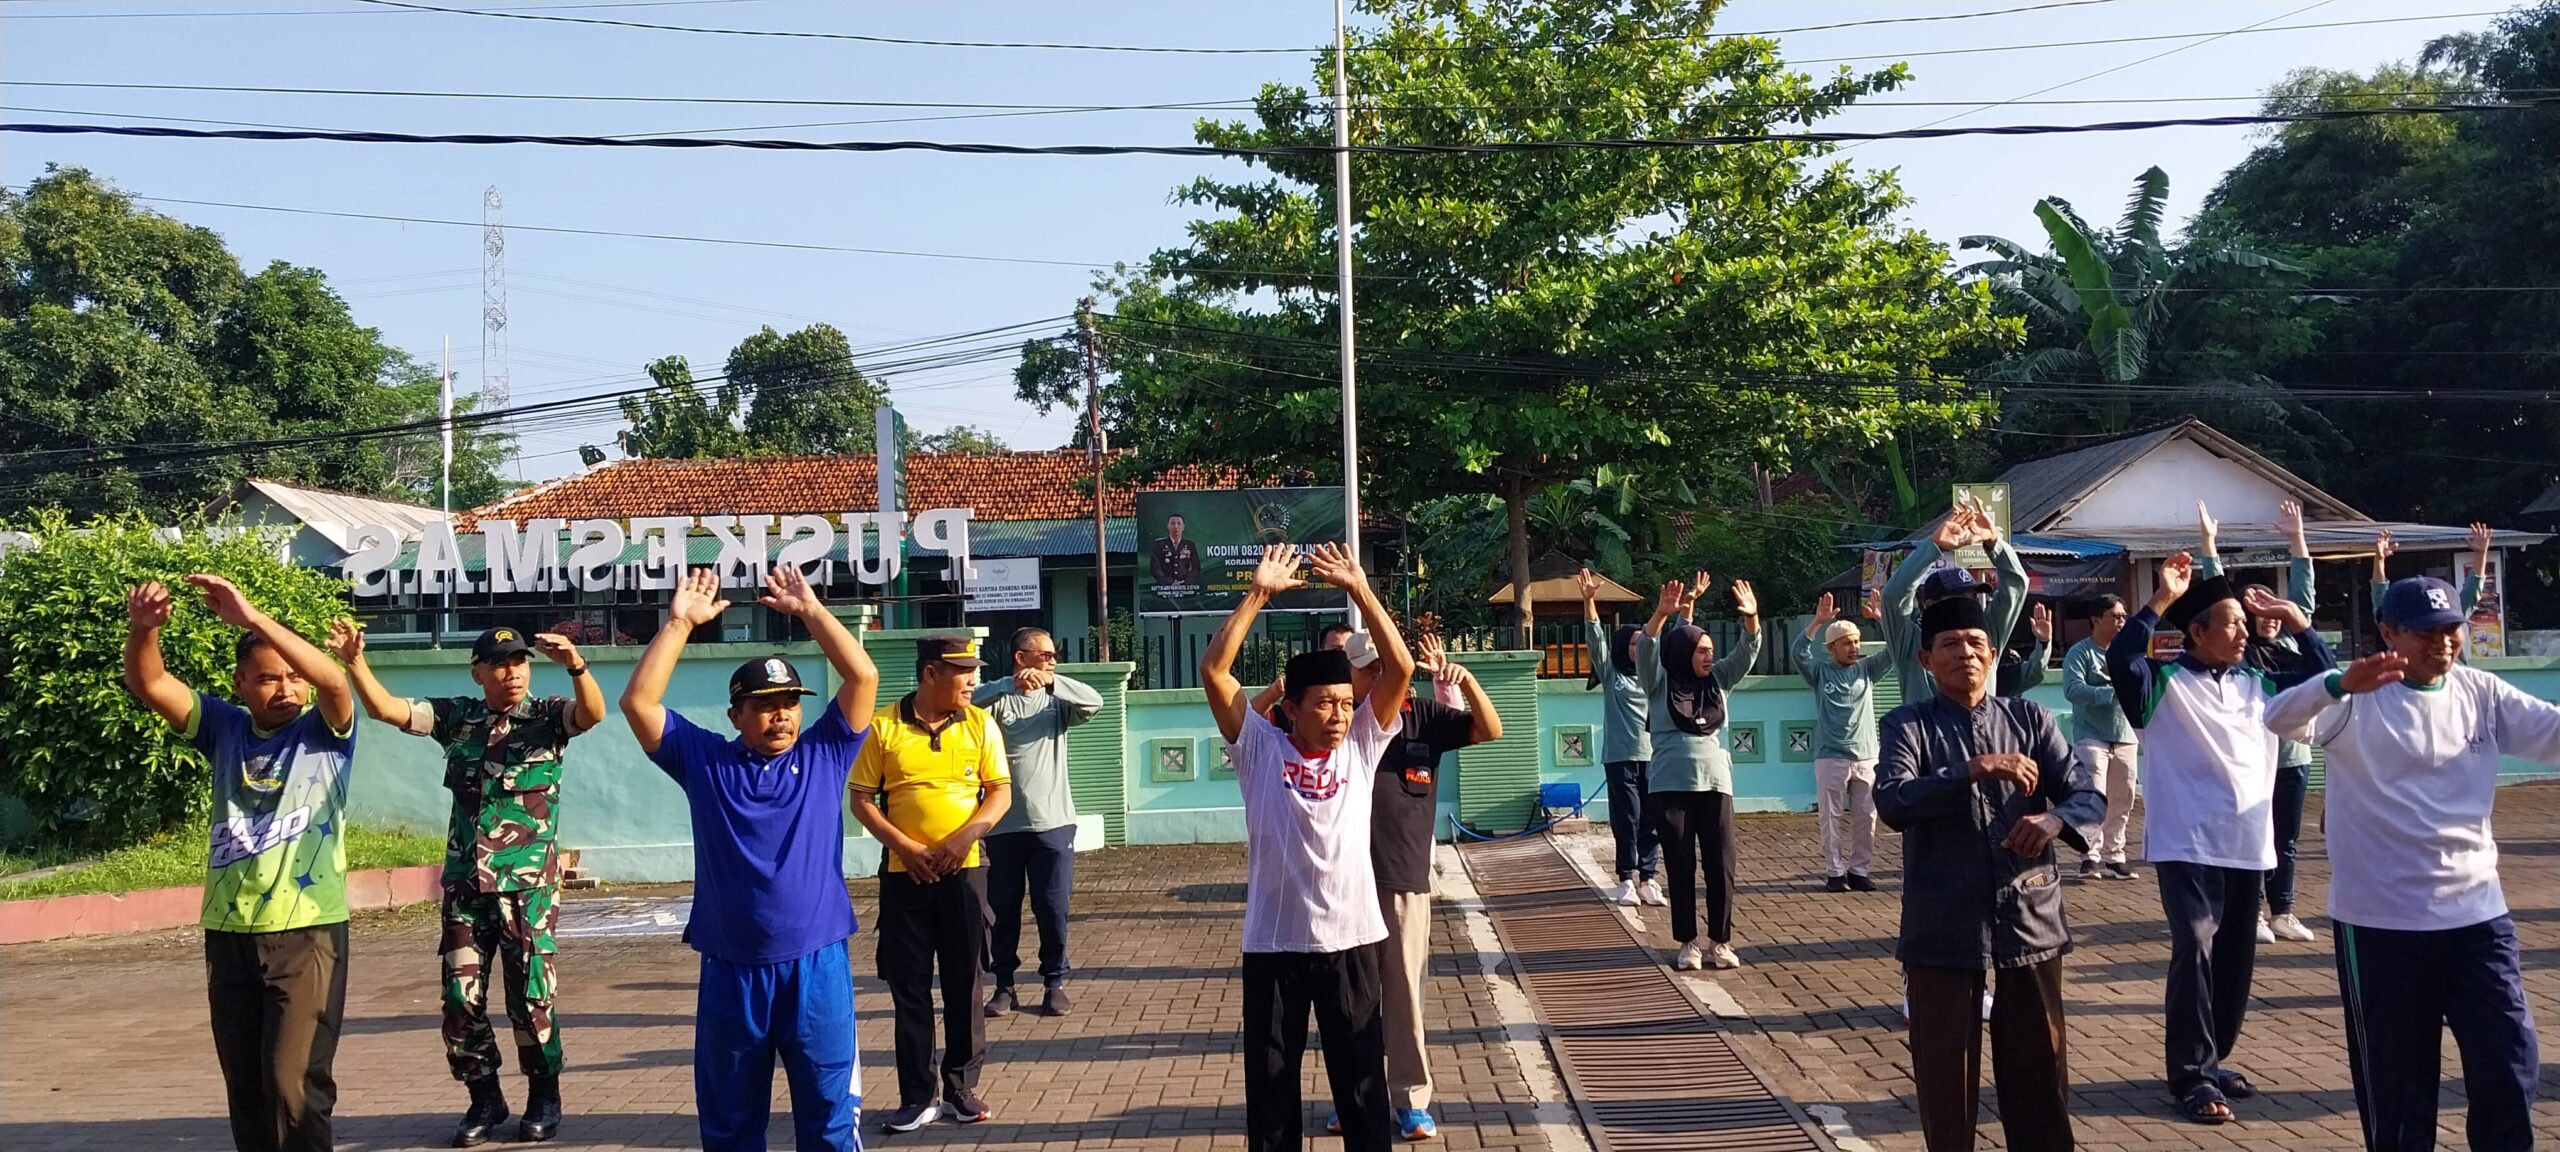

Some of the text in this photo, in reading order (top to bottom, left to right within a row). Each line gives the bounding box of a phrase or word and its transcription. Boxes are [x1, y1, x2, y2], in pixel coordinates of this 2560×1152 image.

[1206, 544, 1239, 557] KODIM
[1241, 543, 1264, 557] 0820
[1957, 549, 1976, 557] TITIK
[1224, 558, 1260, 566] KORAMIL
